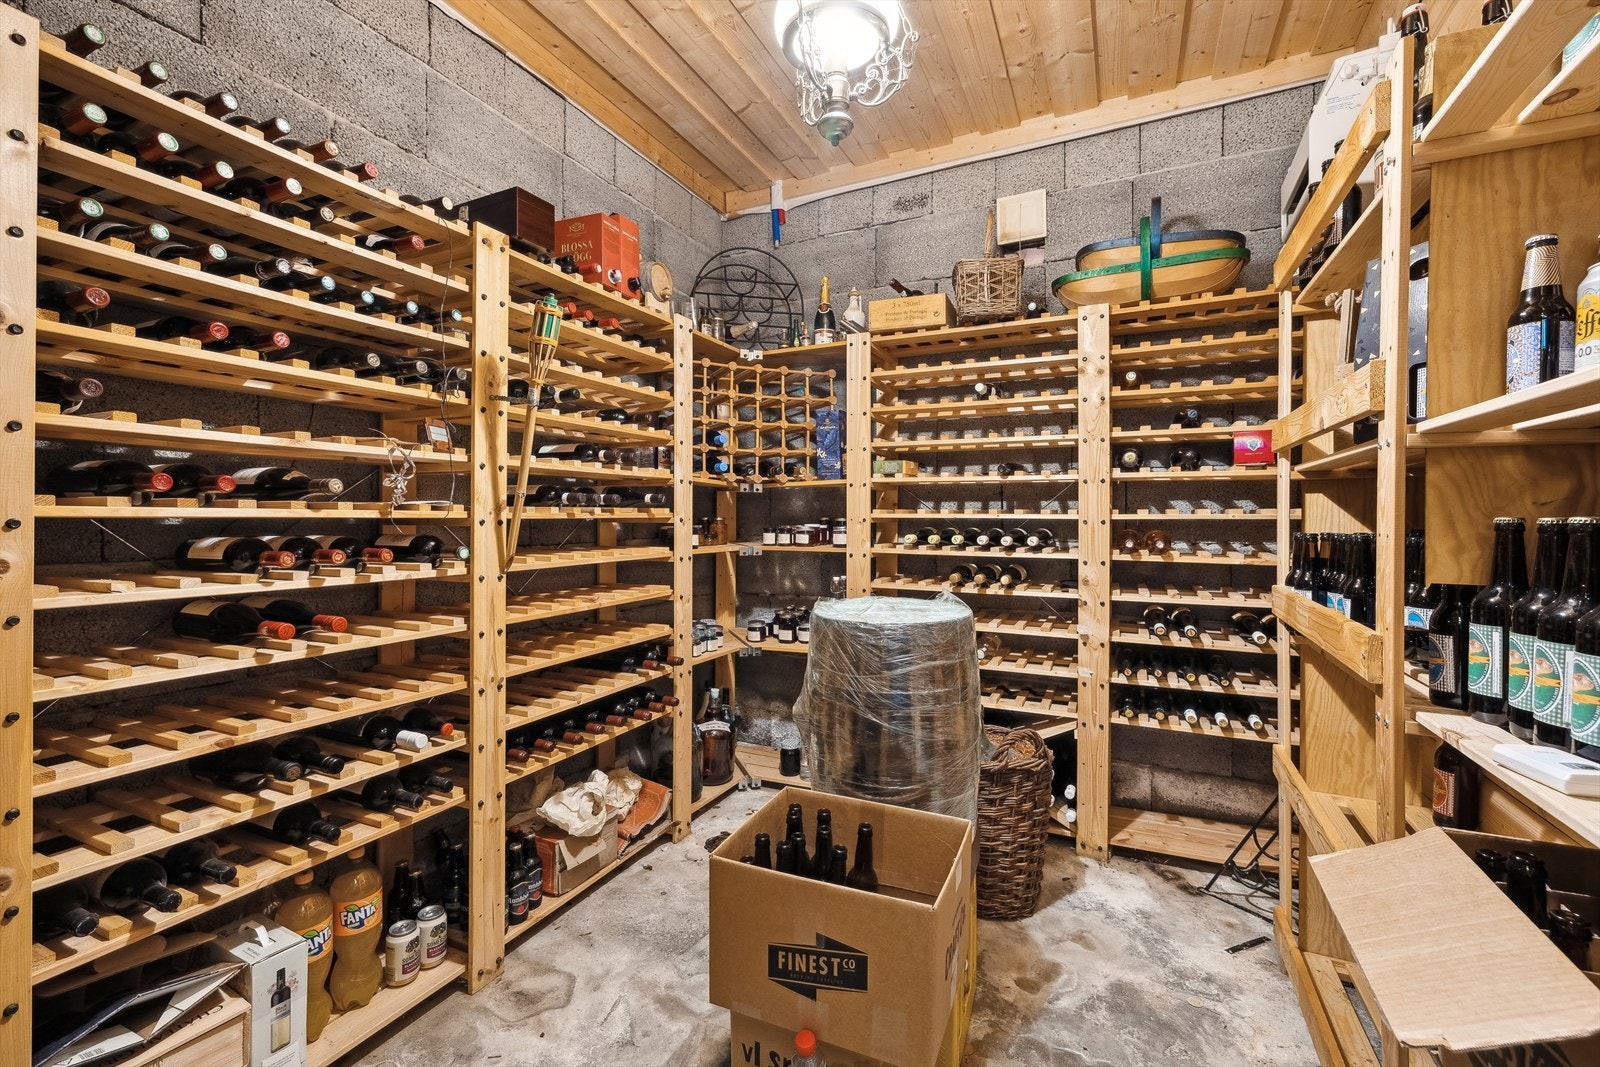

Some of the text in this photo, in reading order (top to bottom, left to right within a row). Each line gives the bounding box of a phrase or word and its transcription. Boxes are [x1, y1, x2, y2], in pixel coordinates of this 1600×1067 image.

[561, 240, 593, 253] BLOSSA
[573, 251, 592, 262] ÖGG
[340, 904, 376, 925] FANTA
[306, 927, 332, 950] ANTA
[778, 951, 856, 977] FINEST CO
